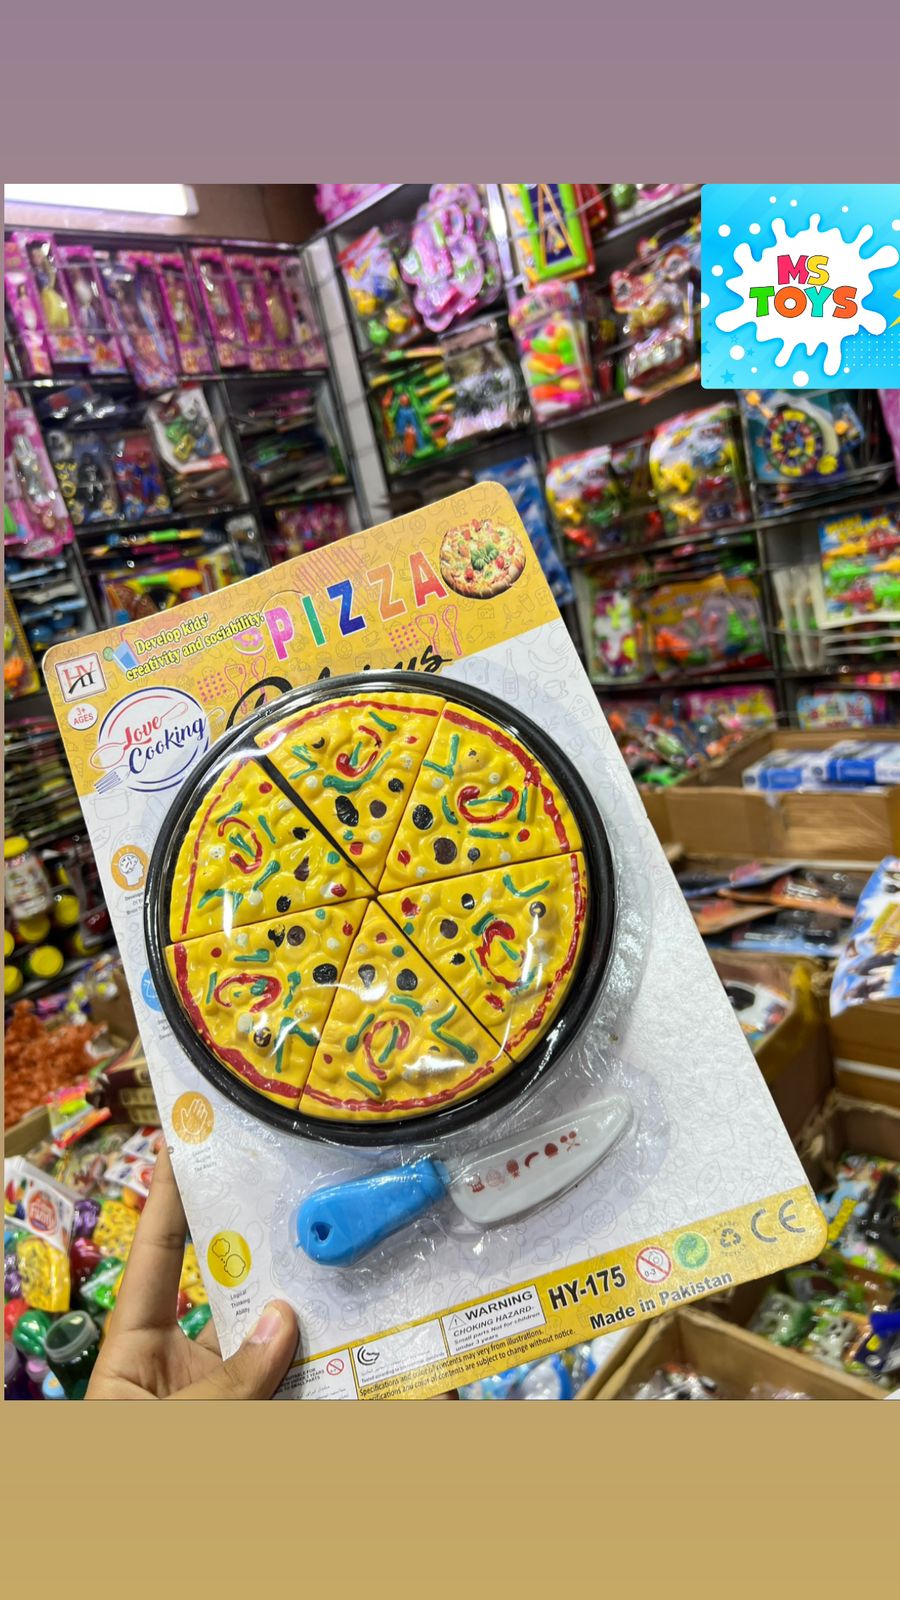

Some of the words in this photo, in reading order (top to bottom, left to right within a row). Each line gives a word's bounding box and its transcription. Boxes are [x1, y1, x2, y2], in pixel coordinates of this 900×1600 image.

[264, 550, 449, 661] PIZZA
[125, 649, 181, 681] creativity
[182, 636, 206, 657] and
[204, 611, 265, 646] sociability.
[134, 628, 181, 655] Develop
[179, 613, 209, 636] kids'
[73, 713, 94, 726] AGES
[77, 706, 86, 717] 3+
[123, 715, 162, 751] Love
[129, 717, 206, 774] Cooking
[548, 1265, 627, 1310] HY-175
[644, 1268, 657, 1278] 0-3
[465, 1291, 533, 1320] WARNING
[590, 1306, 635, 1330] Made
[639, 1298, 655, 1313] in
[659, 1272, 733, 1306] Pakistan
[453, 1318, 494, 1337] CHOKING
[454, 1334, 472, 1345] Small
[473, 1329, 490, 1339] parts
[514, 1312, 541, 1324] children
[455, 1342, 474, 1352] under
[359, 1378, 399, 1397] Specifications
[462, 1352, 476, 1362] may
[475, 1346, 490, 1359] very
[490, 1340, 507, 1352] from
[506, 1329, 545, 1347] illustrations.
[465, 1362, 476, 1372] are
[475, 1354, 499, 1369] subject
[498, 1352, 507, 1361] to
[506, 1342, 530, 1357] change
[528, 1334, 555, 1349] without
[554, 1328, 577, 1341] notice.
